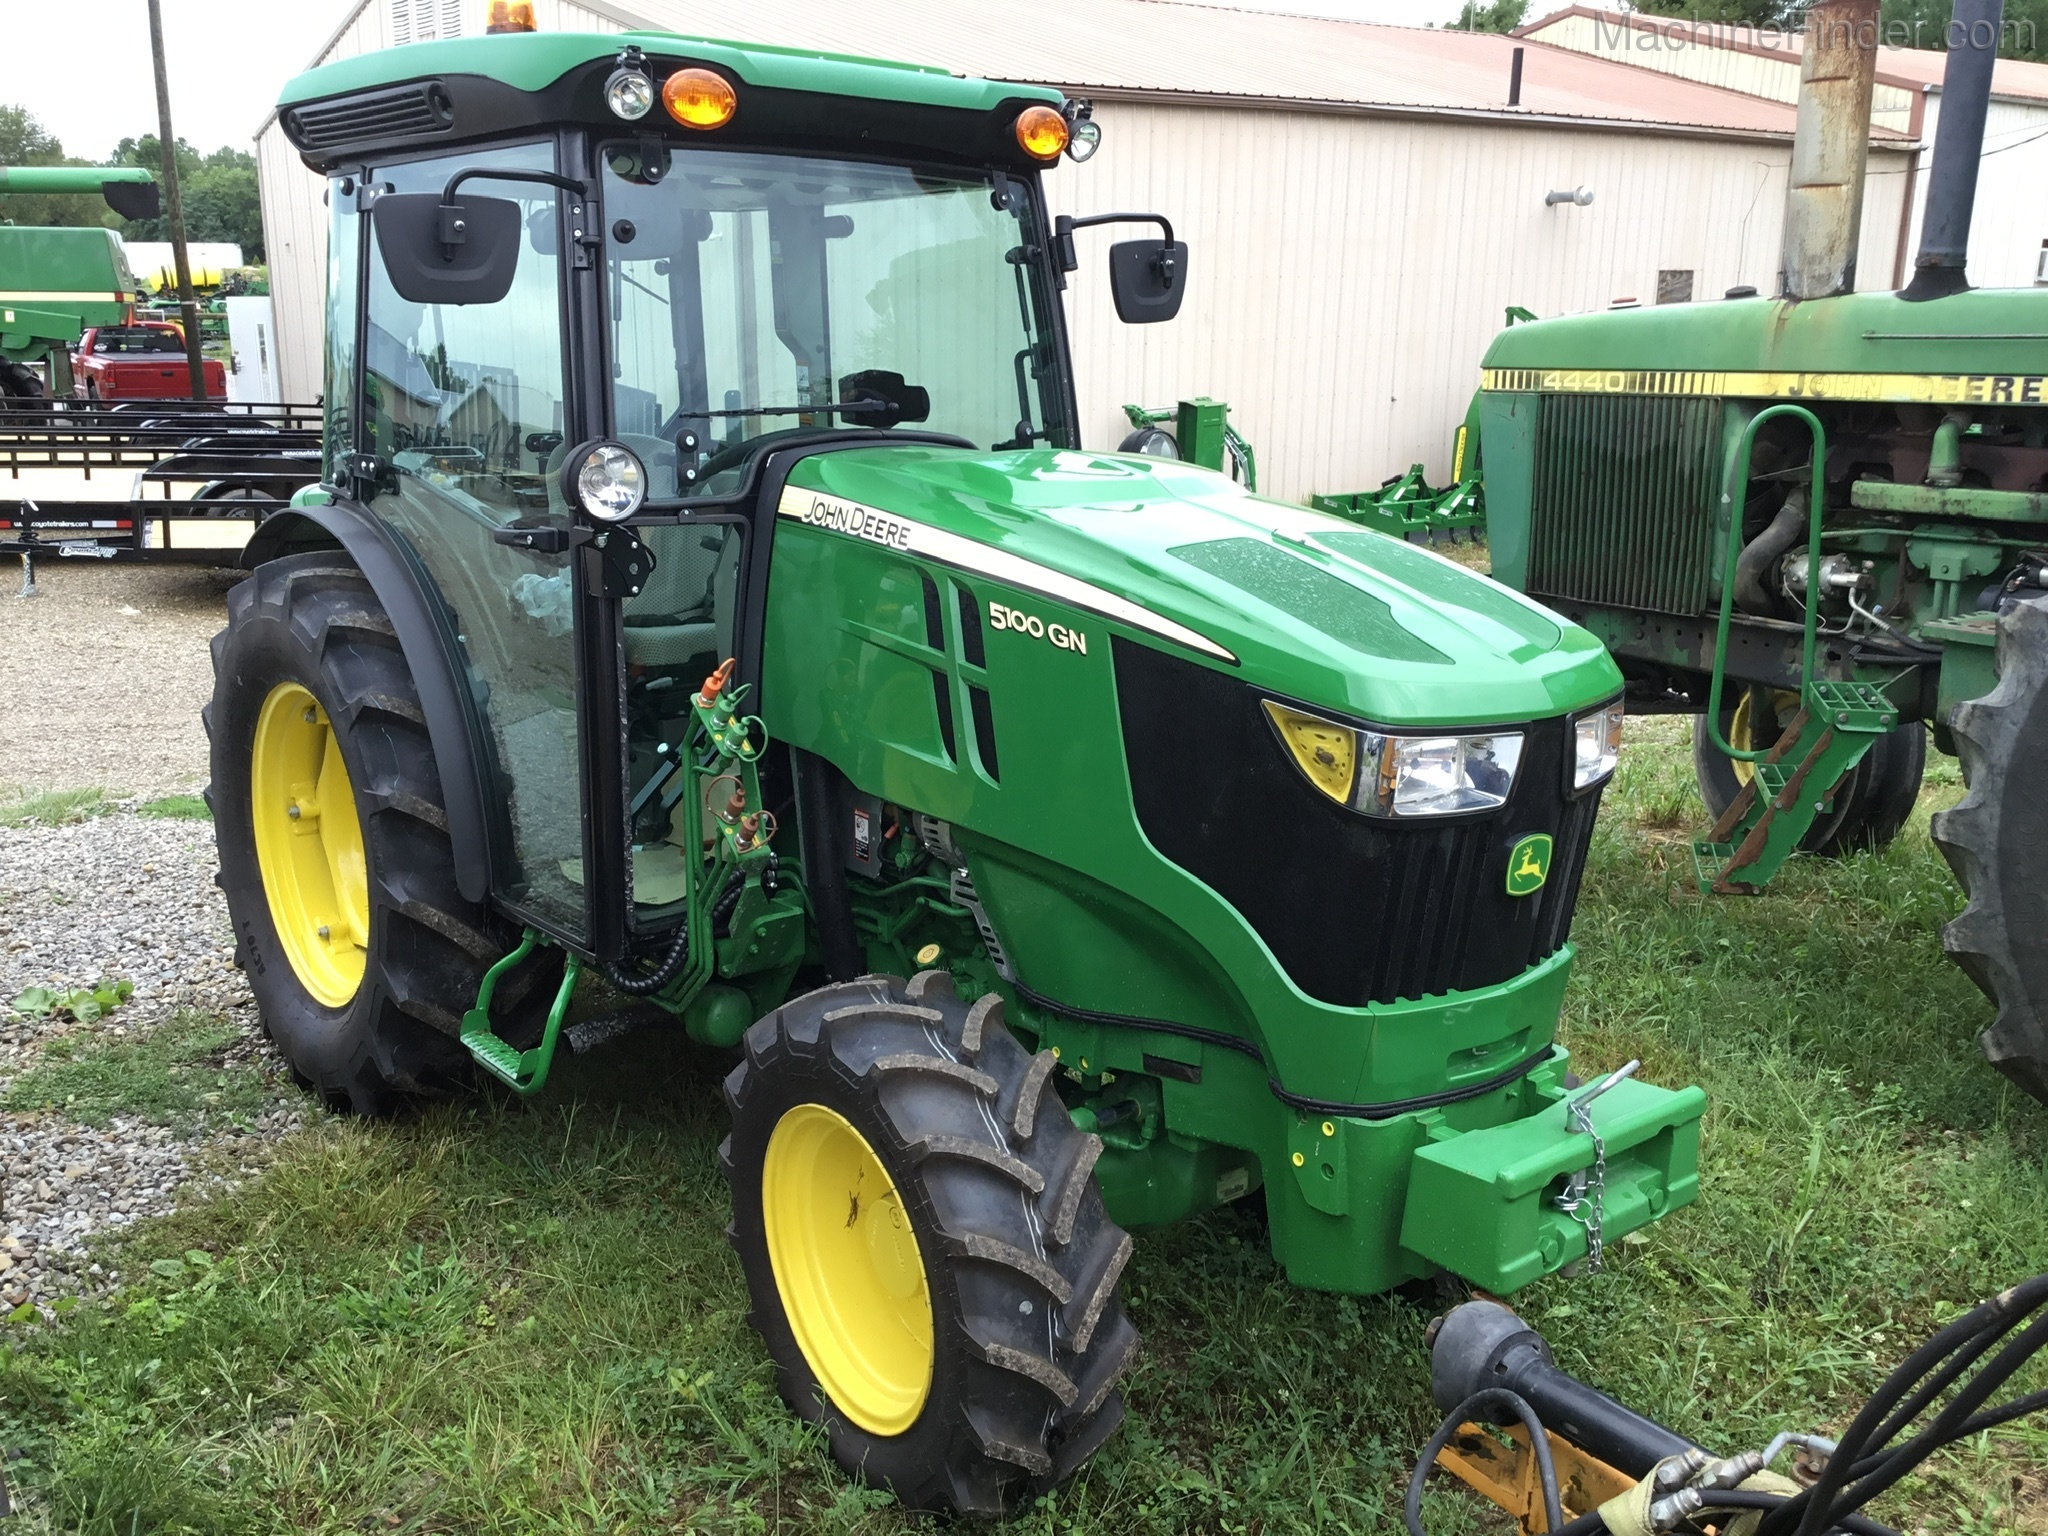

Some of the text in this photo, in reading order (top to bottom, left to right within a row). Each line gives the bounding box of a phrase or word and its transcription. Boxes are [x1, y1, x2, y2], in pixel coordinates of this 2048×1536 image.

[1543, 371, 1625, 393] 4440
[1788, 374, 2044, 403] JOHN DEERE
[803, 495, 912, 547] JOHN DEERE
[988, 601, 1087, 656] 5100 GN
